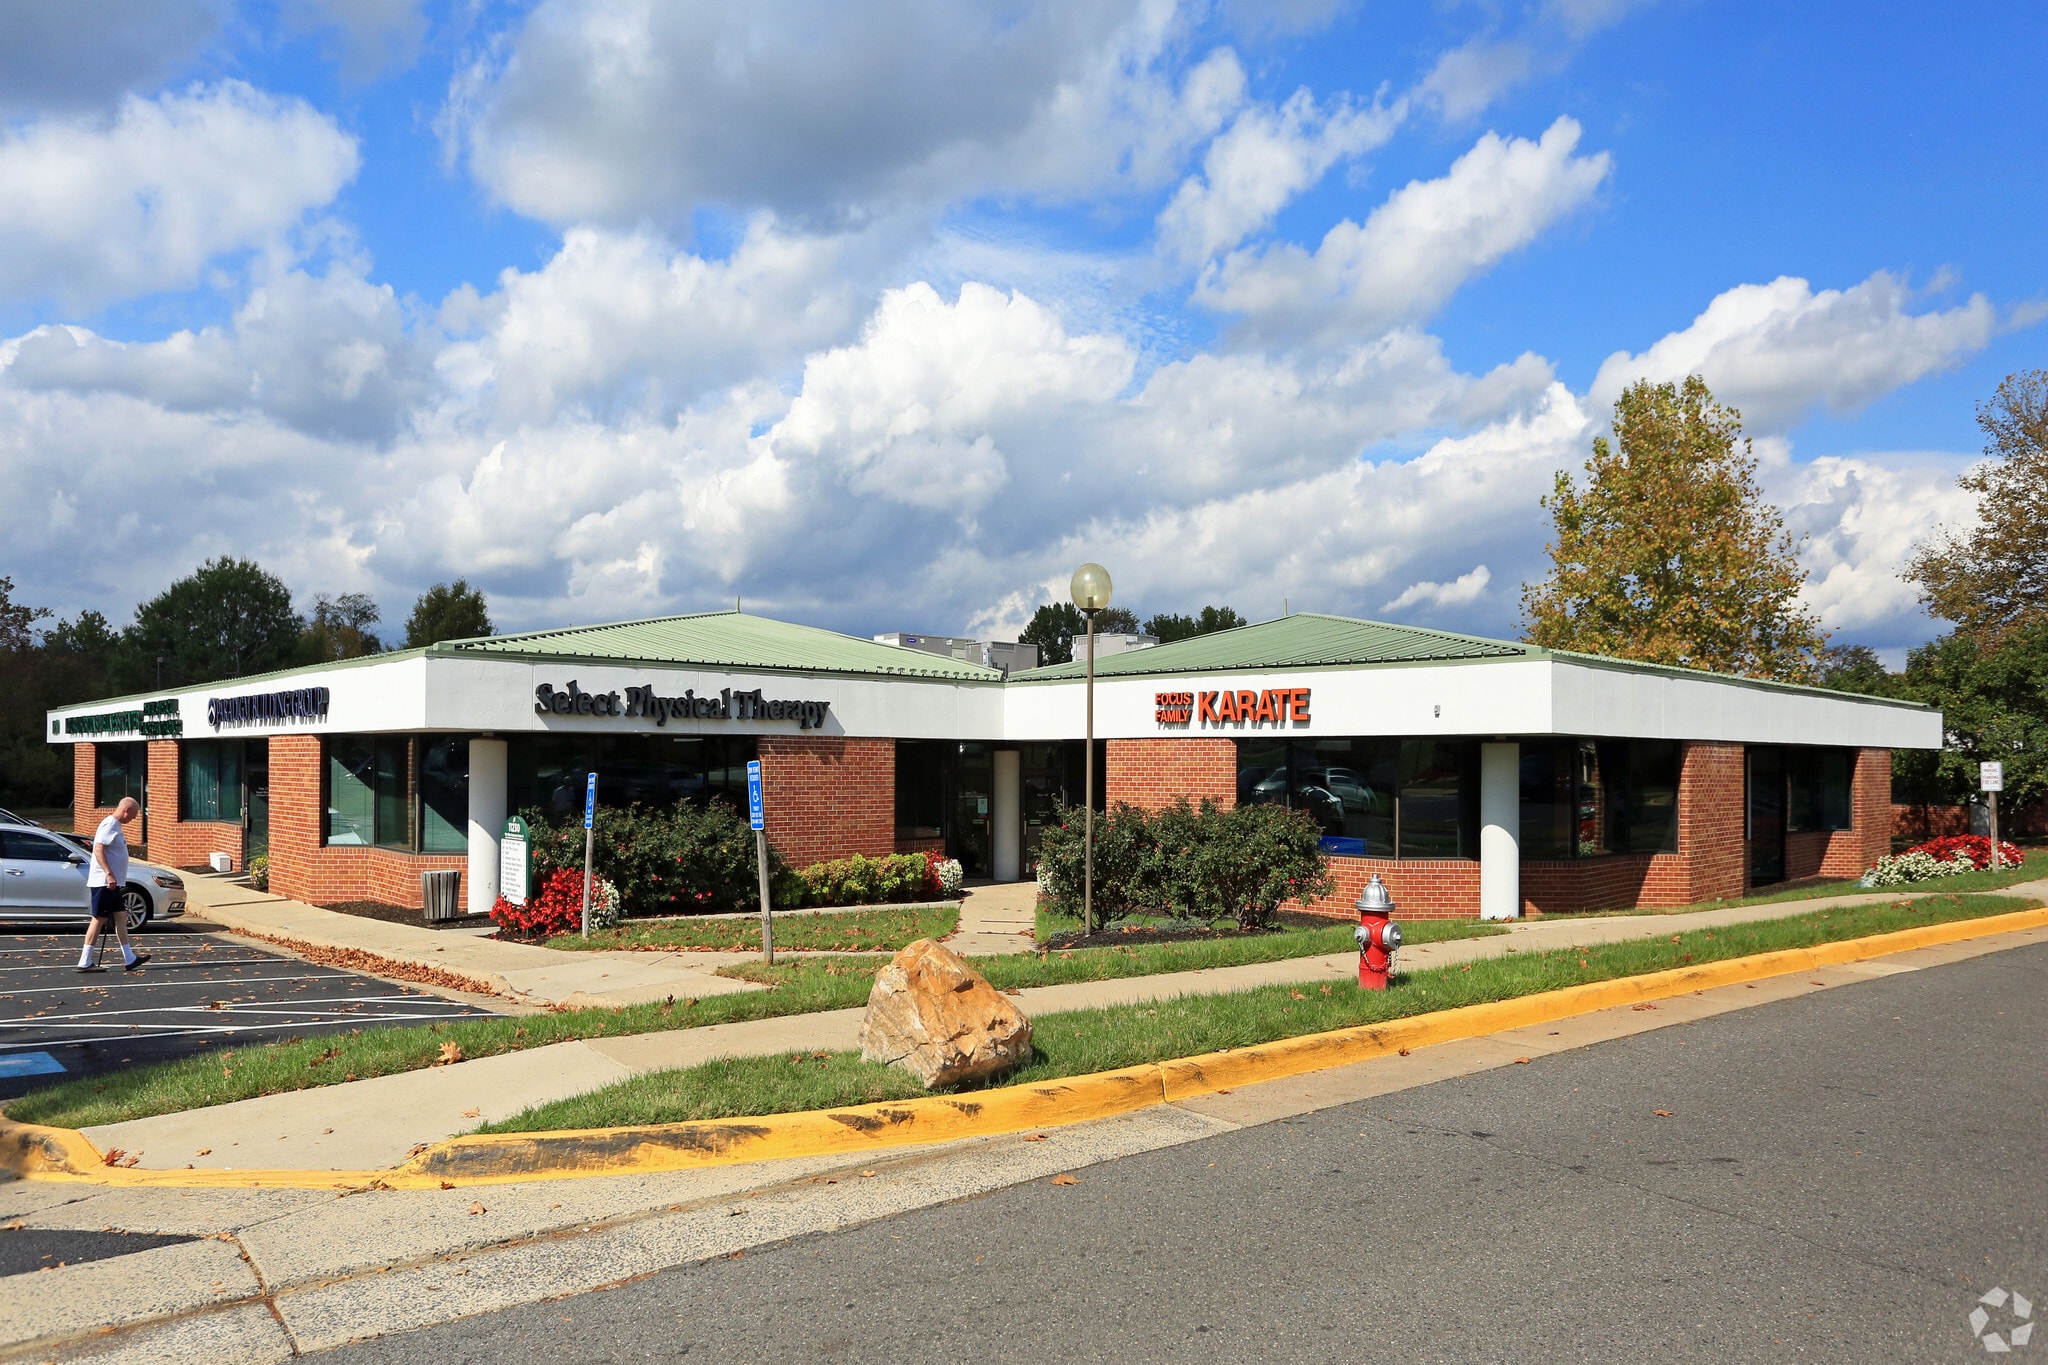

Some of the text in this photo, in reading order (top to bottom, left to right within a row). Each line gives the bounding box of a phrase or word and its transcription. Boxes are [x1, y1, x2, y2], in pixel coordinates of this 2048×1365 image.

[252, 691, 289, 720] BUILDING
[291, 686, 323, 718] GROUP
[535, 679, 830, 730] Select Physical Therapy
[1155, 692, 1192, 706] FOCUS
[1155, 709, 1190, 723] FAMILY
[1198, 688, 1309, 722] KARATE
